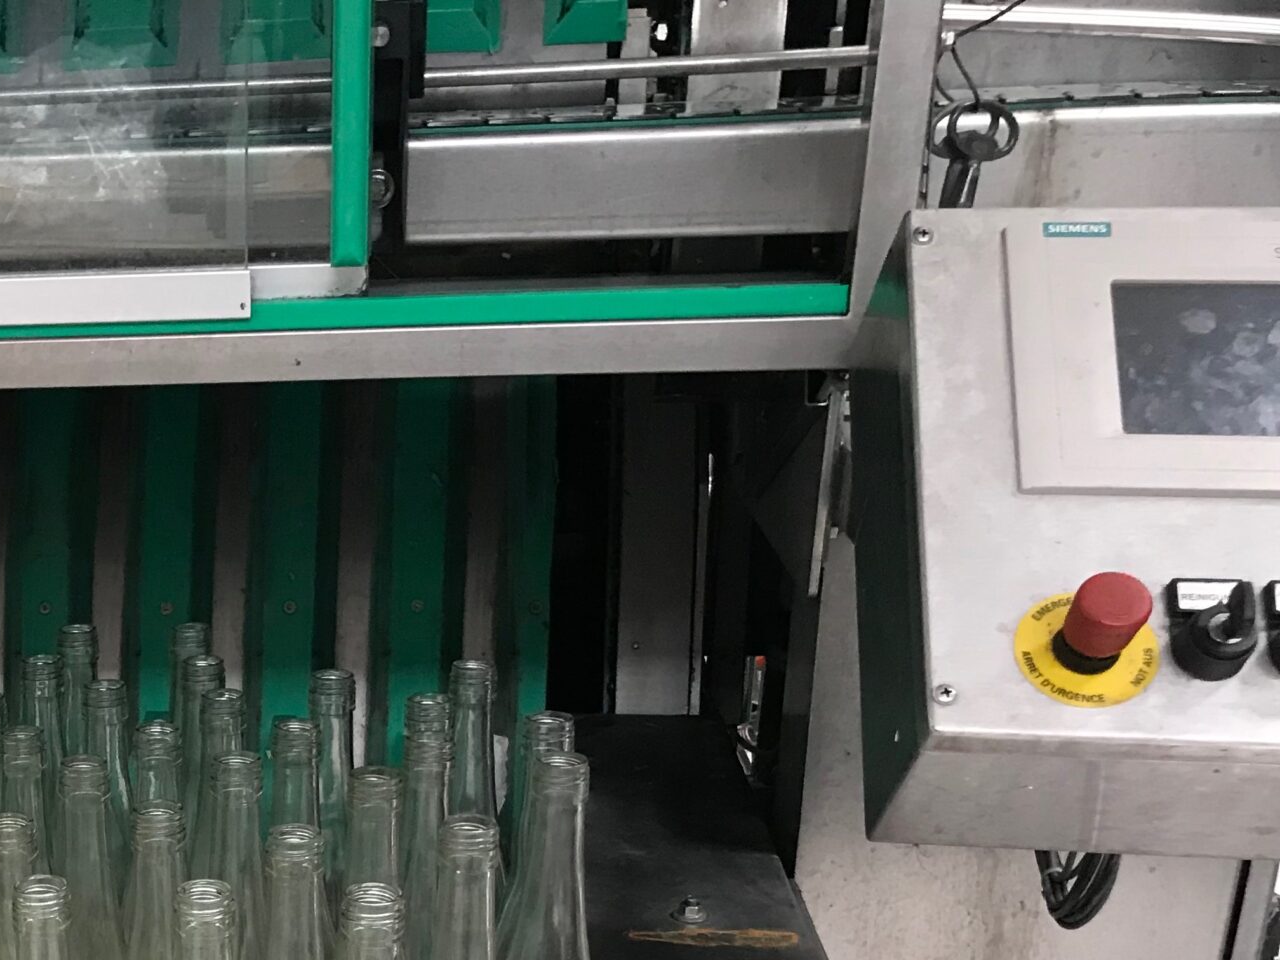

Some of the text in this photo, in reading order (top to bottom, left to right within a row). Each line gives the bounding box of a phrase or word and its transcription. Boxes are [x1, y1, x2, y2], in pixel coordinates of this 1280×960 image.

[1047, 224, 1107, 233] SIEMENS
[1031, 596, 1074, 622] EMERGE
[1021, 650, 1106, 703] ARRET D'URGENCE
[1130, 647, 1154, 687] NOT AUS
